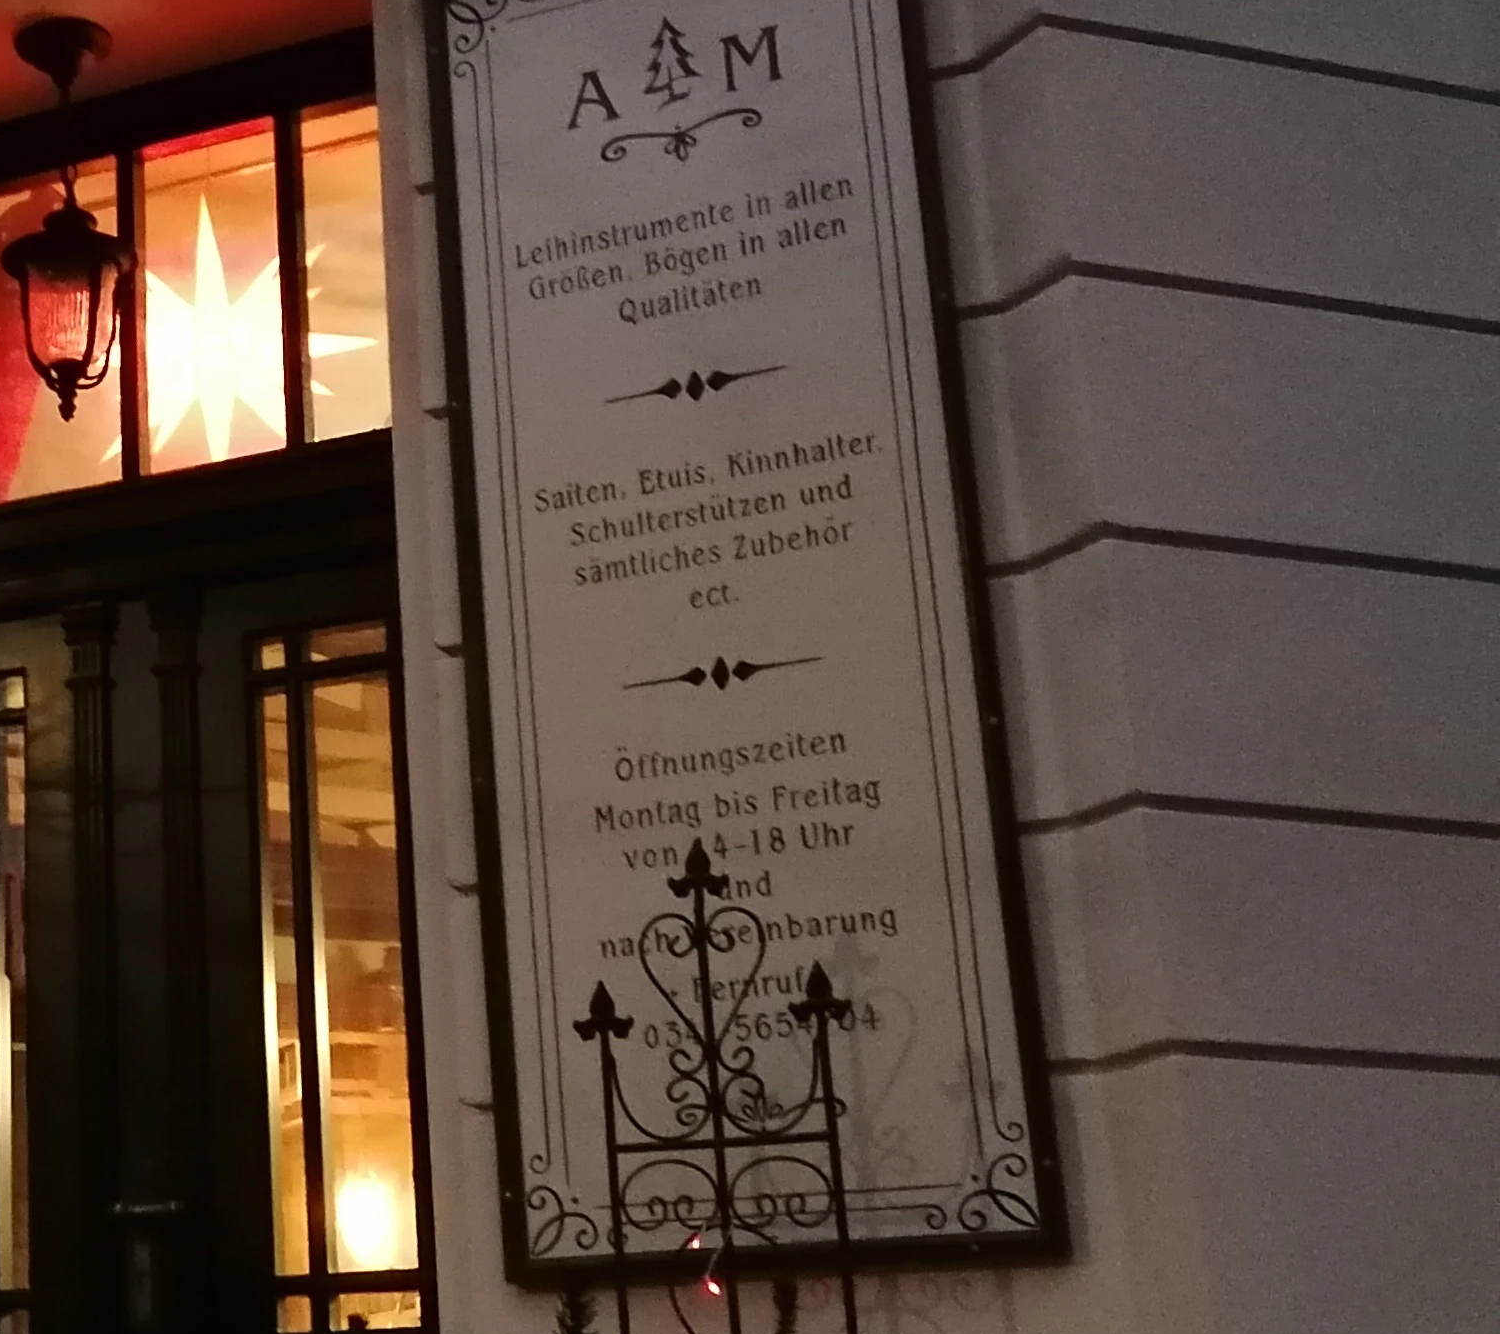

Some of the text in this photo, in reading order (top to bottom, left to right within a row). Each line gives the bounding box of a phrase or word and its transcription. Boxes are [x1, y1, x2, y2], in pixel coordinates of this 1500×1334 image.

[567, 25, 784, 130] A M
[515, 176, 854, 269] Leihinstrumente in allen
[644, 241, 728, 279] Bögen
[739, 231, 766, 258] in
[778, 215, 848, 250] allen
[618, 275, 763, 326] Qualitäten
[533, 478, 626, 513] Saiten,
[639, 464, 716, 496] Etuis,
[569, 474, 853, 547] Schulterstützen und
[574, 515, 853, 586] sämtliches Zubehör
[687, 584, 740, 610] ect.
[614, 731, 847, 782] Öffnungszeiten
[594, 777, 883, 835] Montag bis Freitag
[623, 820, 856, 870] von 4-18 Uhr
